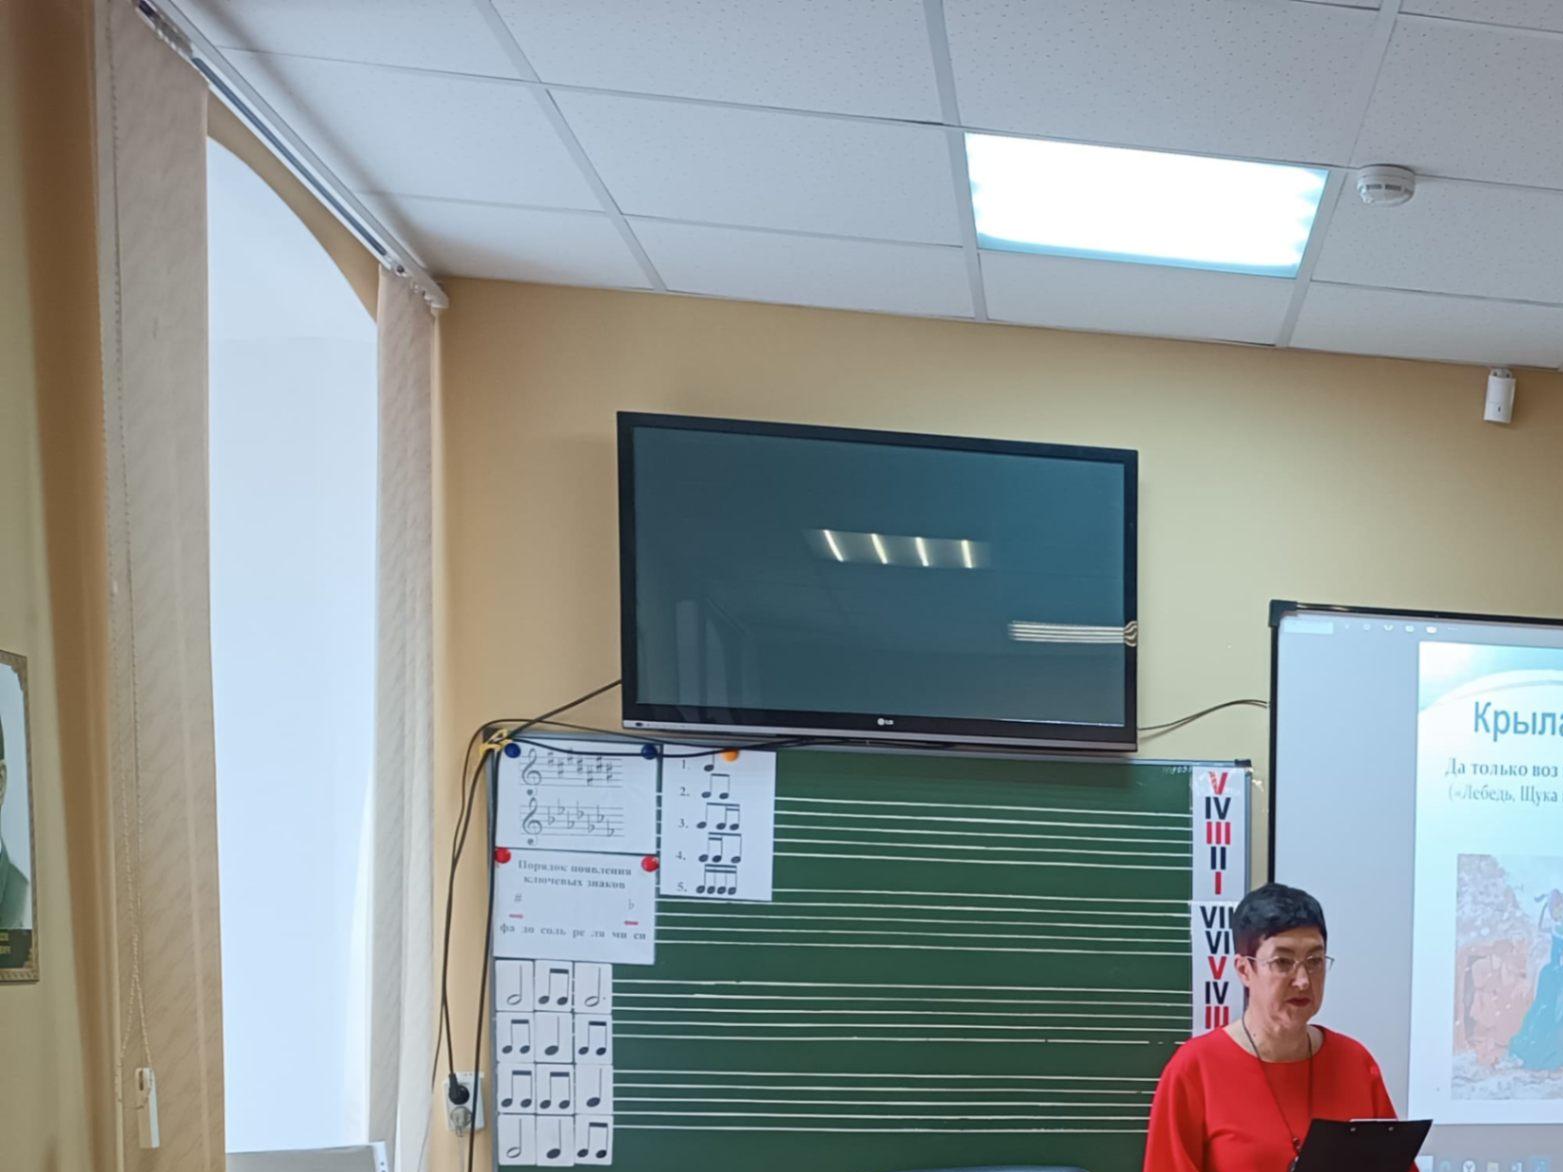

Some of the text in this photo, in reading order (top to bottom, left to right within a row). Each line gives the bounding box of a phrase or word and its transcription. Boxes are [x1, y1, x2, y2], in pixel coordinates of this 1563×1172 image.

[1445, 758, 1466, 777] Да
[1470, 762, 1527, 777] только
[1532, 765, 1558, 779] воз
[1208, 772, 1228, 795] V
[1205, 797, 1231, 819] IV
[1520, 788, 1558, 807] Щука
[1206, 822, 1231, 844] III
[518, 860, 567, 872] Порядок
[1211, 847, 1226, 869] II
[1215, 872, 1221, 894] I
[500, 923, 515, 934] фа
[1208, 956, 1227, 979] V
[1205, 981, 1229, 1004] IV
